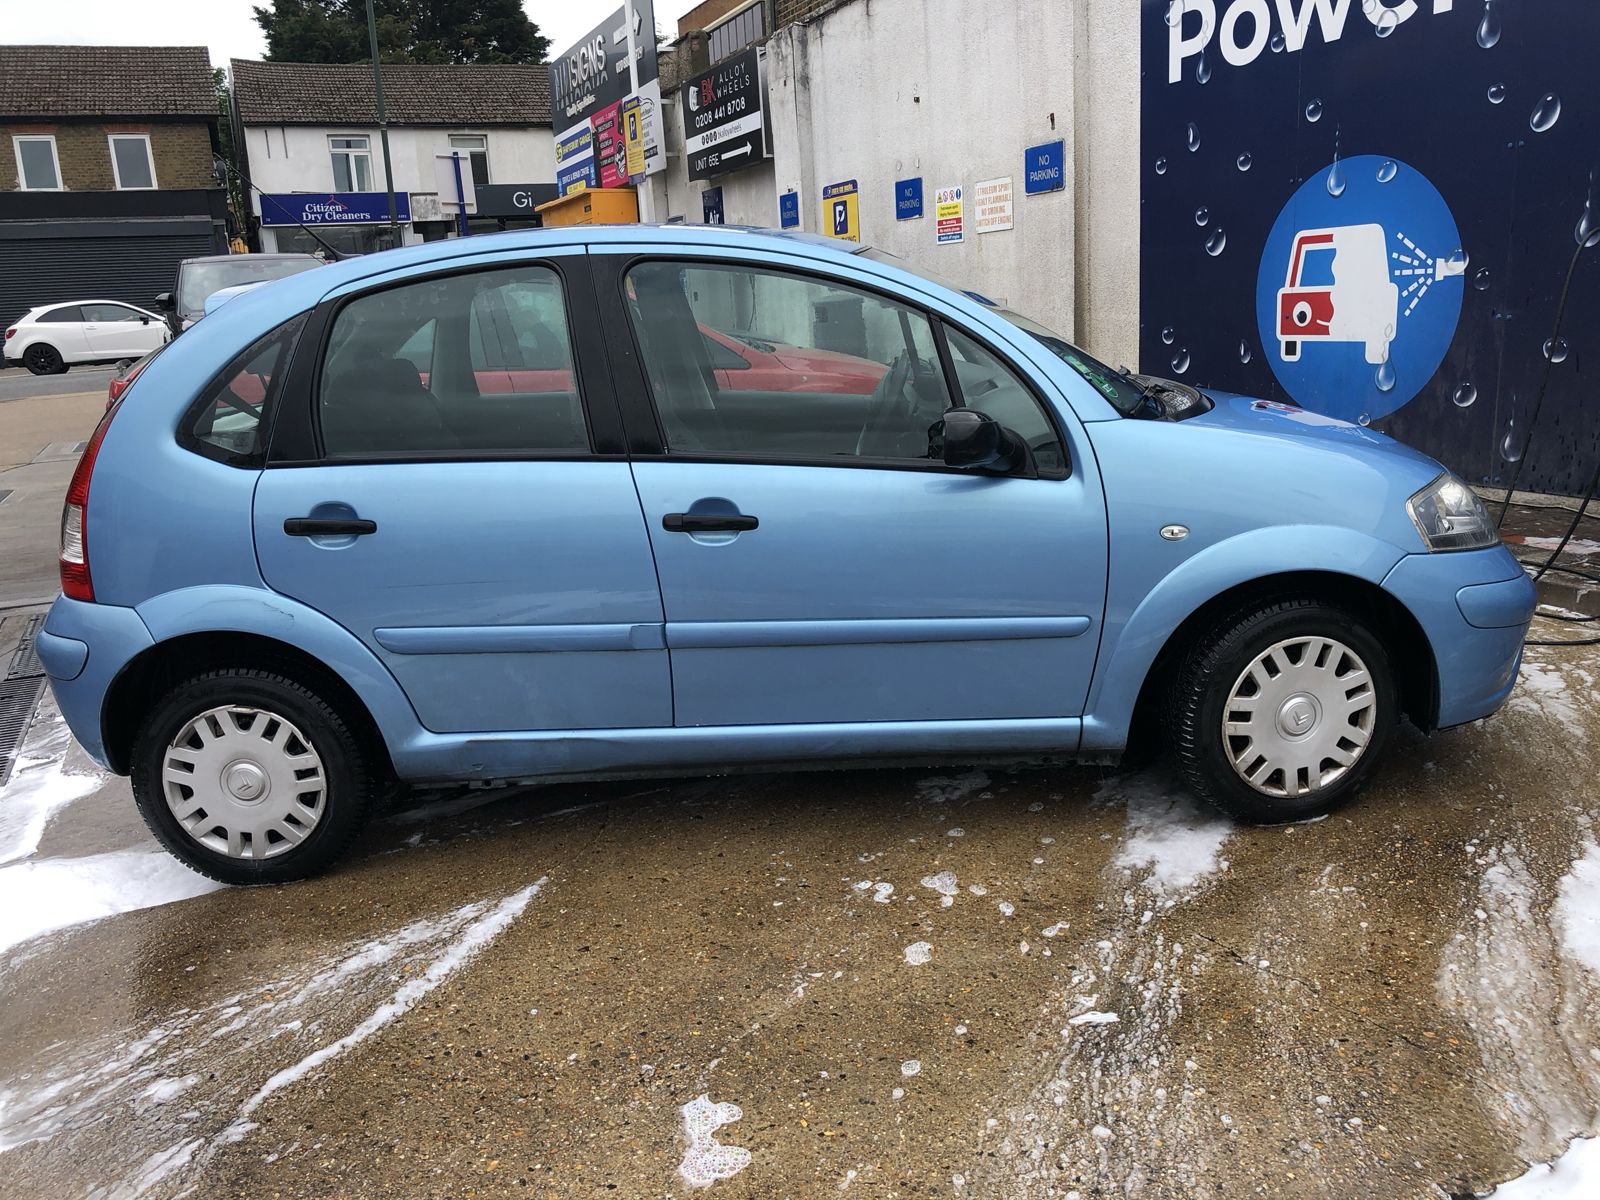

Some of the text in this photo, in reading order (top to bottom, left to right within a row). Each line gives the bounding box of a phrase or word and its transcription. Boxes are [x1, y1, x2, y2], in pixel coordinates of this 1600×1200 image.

[1169, 0, 1452, 83] Powe
[719, 62, 745, 83] ALLOY
[717, 75, 750, 98] WHEELS
[695, 97, 746, 128] 0208 441 8708
[695, 157, 707, 171] UNIT
[1038, 154, 1050, 166] NO
[1030, 167, 1059, 182] PARKING
[905, 188, 913, 197] NO
[305, 203, 342, 213] Citizen
[899, 199, 920, 209] PARKING
[302, 212, 323, 222] Dry
[324, 211, 371, 220] Cleaners
[709, 210, 720, 224] Air
